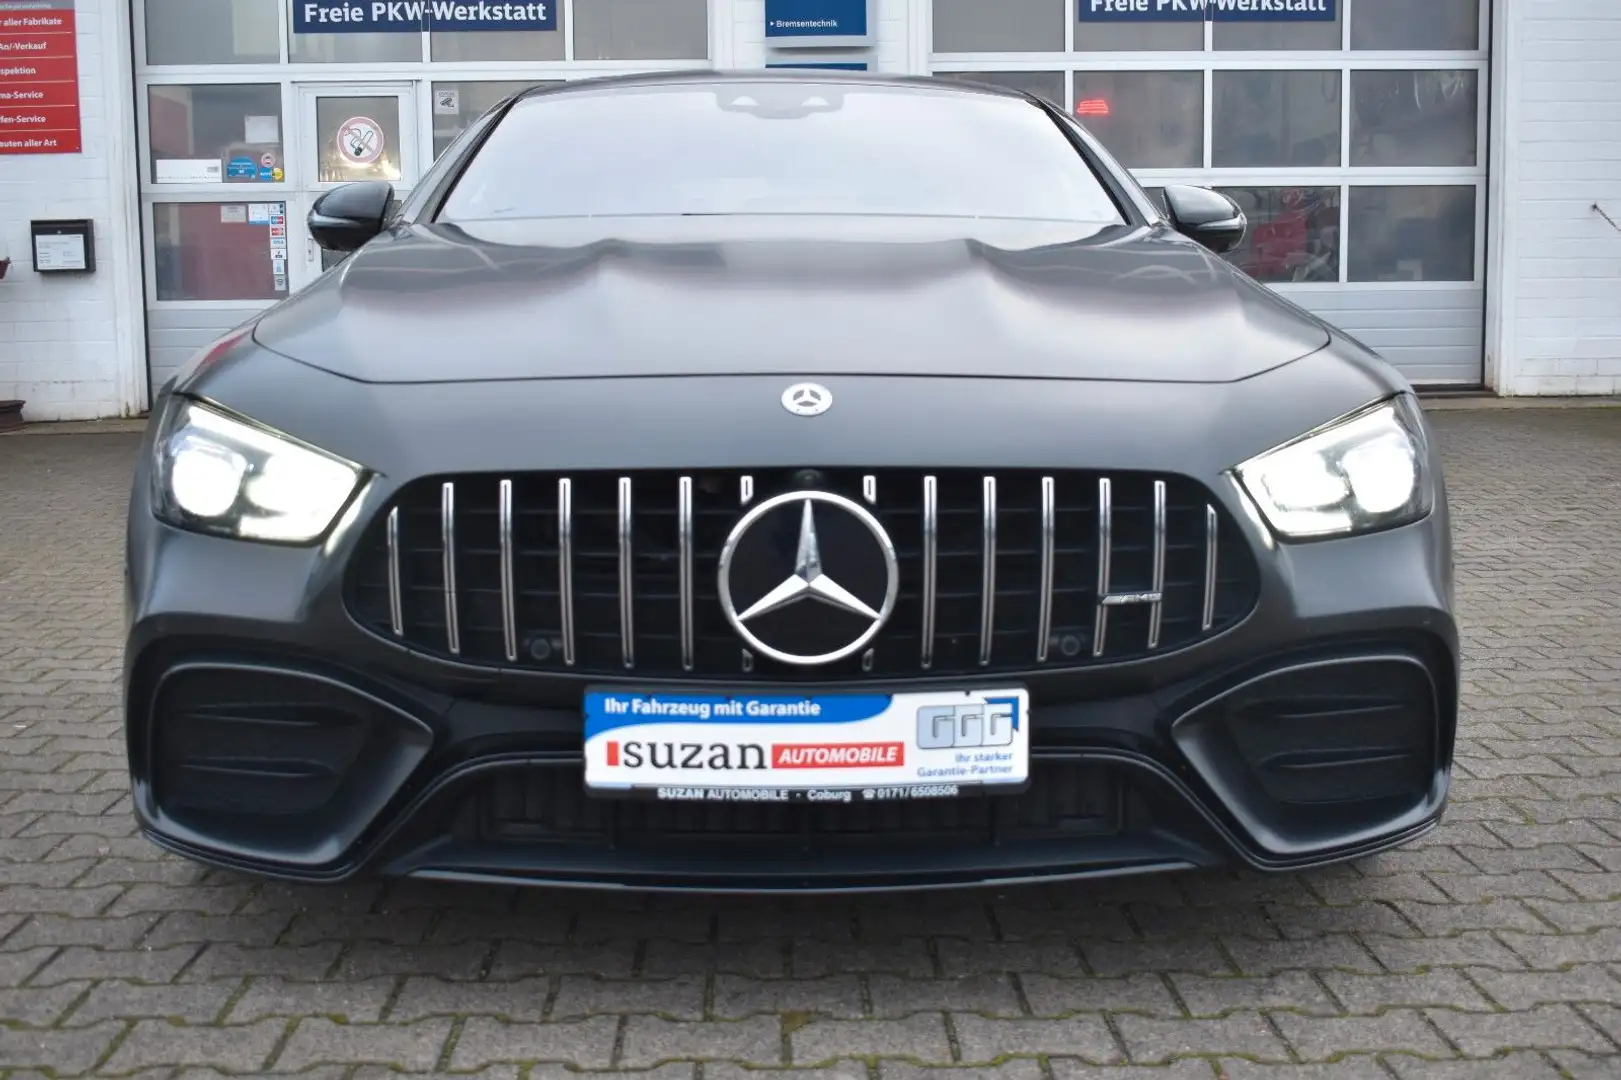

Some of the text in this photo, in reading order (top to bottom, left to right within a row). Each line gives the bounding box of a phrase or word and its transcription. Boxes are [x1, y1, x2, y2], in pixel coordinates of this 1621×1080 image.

[1090, 0, 1326, 12] Freie PKW-Werkstatt
[304, 1, 547, 23] Freie PKW-Werkstatt
[3, 18, 21, 26] aller
[23, 17, 62, 25] Fabrikate
[776, 20, 838, 28] Bremsentechnik
[0, 67, 36, 76] spektion
[0, 115, 46, 123] fen-Service
[24, 139, 42, 147] aller
[44, 138, 57, 146] Art
[604, 698, 822, 719] Ihr Fahrzeug mit Garantie
[622, 740, 899, 770] suzan AUTOMOBILE
[955, 751, 1012, 762] Ihr starker
[917, 765, 1013, 777] Garantie-Partner
[657, 787, 704, 799] SUZAN
[707, 788, 789, 801] AUTOMOBILE
[807, 788, 851, 802] Coburg
